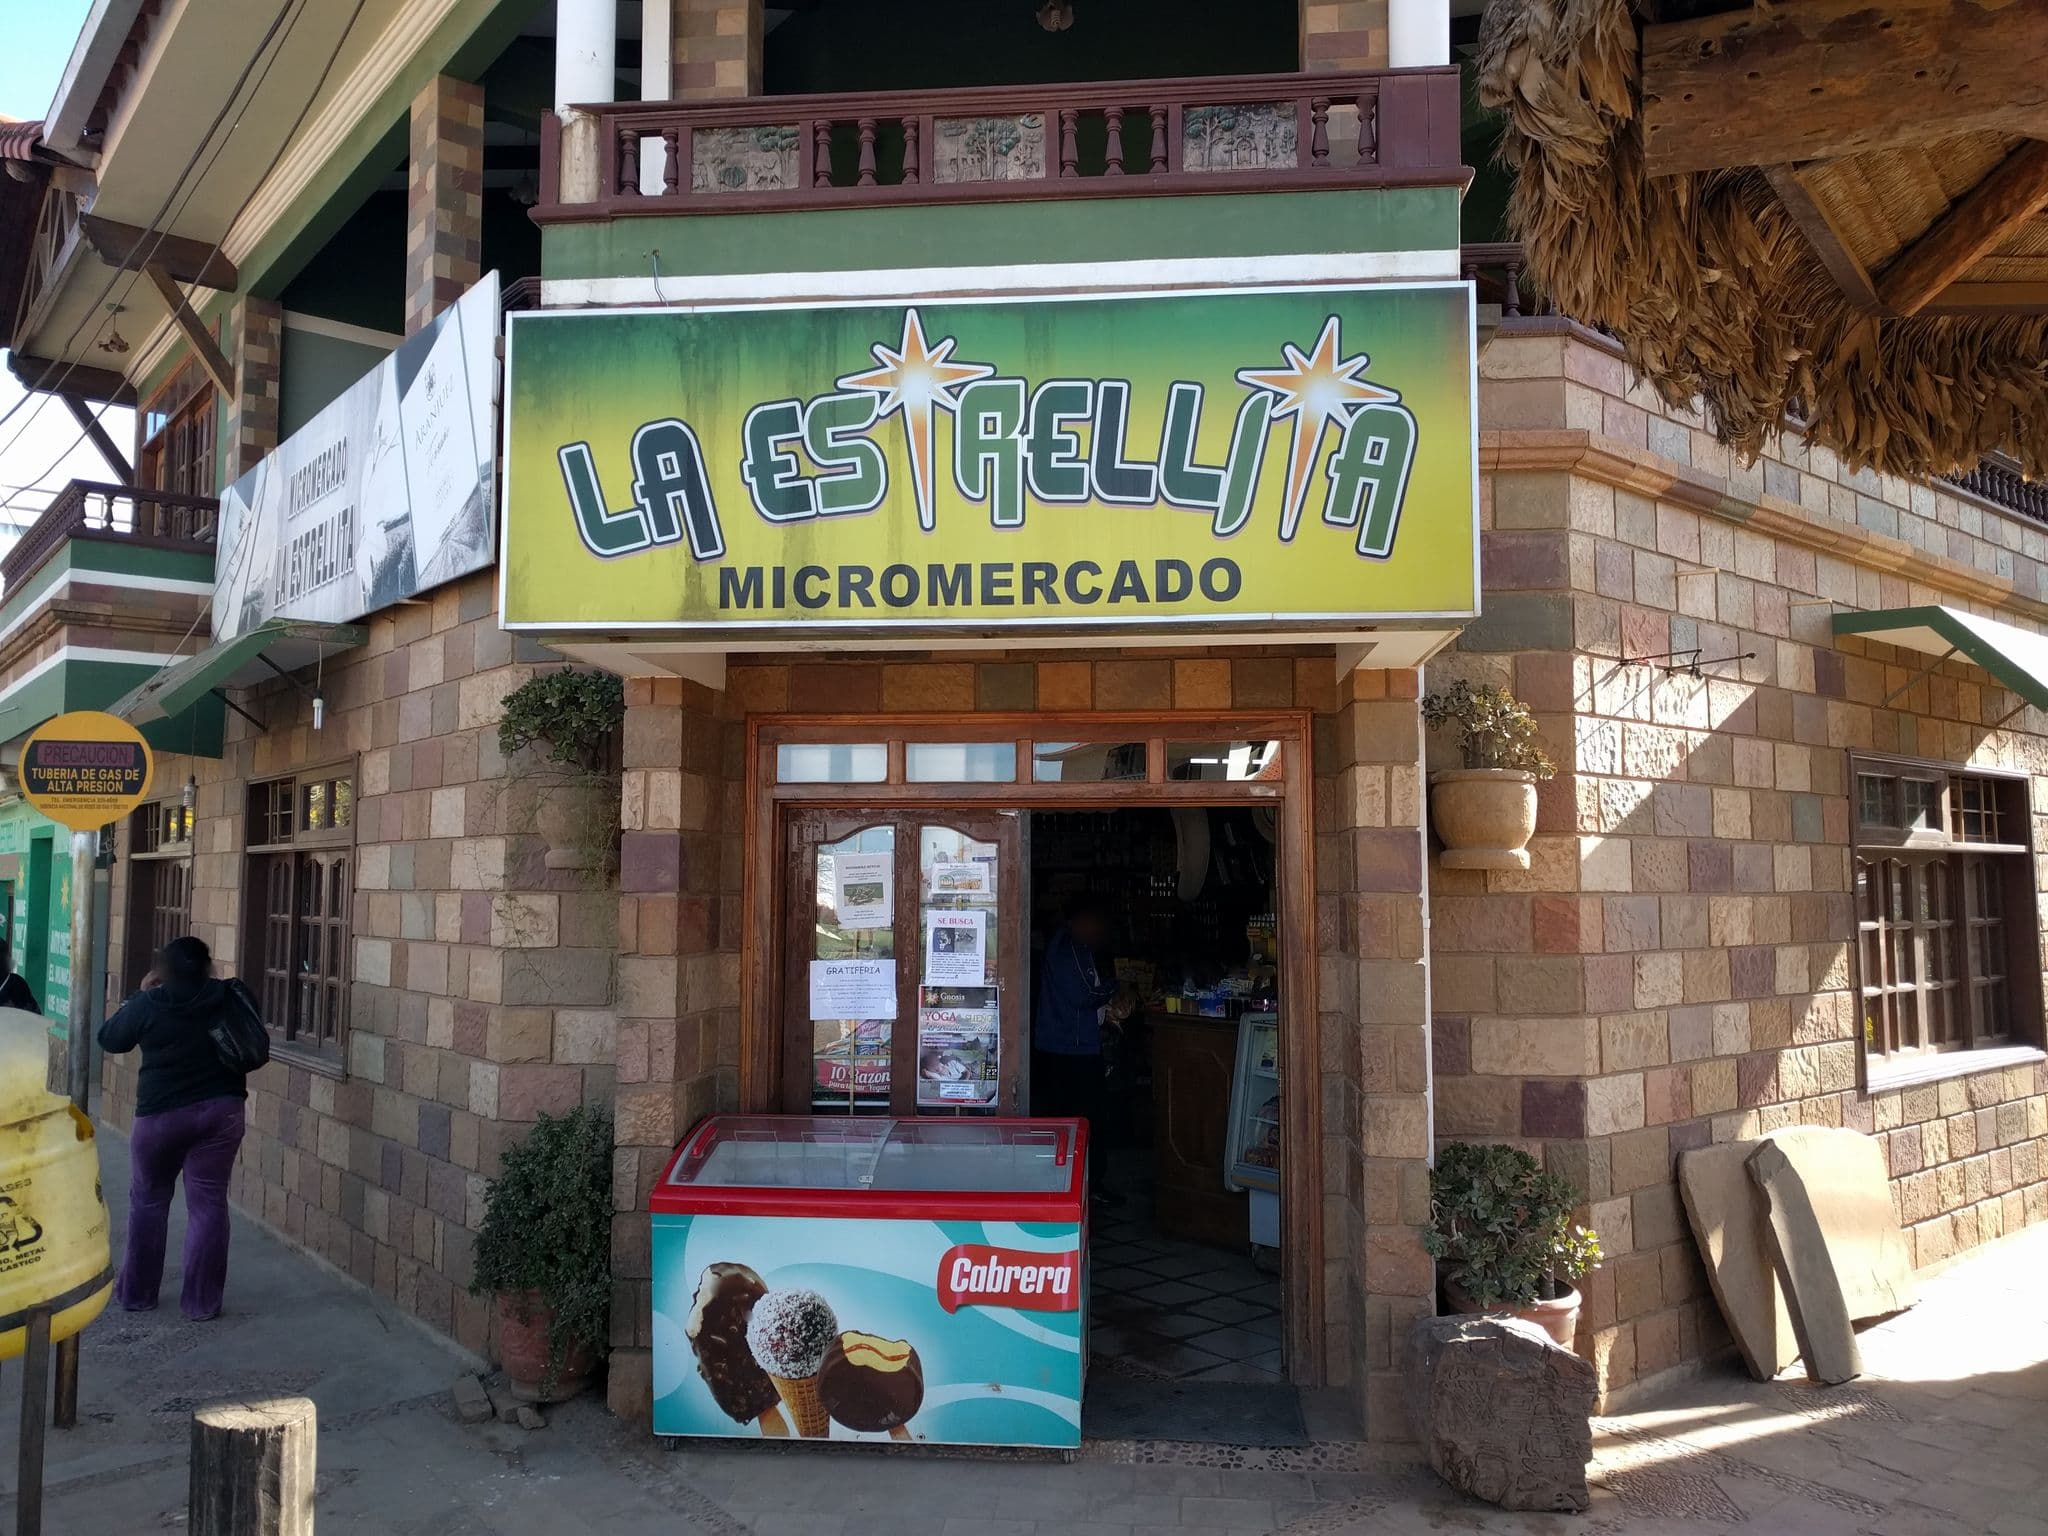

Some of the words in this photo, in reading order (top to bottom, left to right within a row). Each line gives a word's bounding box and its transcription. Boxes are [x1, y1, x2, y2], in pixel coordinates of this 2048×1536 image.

[558, 417, 726, 562] LA
[739, 308, 1417, 561] ESTRELLITA
[288, 436, 347, 520] MICROMERCADO
[274, 545, 288, 610] LA
[289, 505, 355, 603] ESTRELLITA
[719, 557, 1242, 611] MICROMERCADO
[44, 745, 128, 764] PRECAUCION
[32, 767, 78, 780] TUBERIA
[81, 768, 96, 780] DE
[98, 769, 122, 780] GAS
[125, 768, 140, 780] DE
[47, 780, 73, 792] ALTA
[76, 780, 123, 792] PRESION
[937, 917, 947, 925] SE
[949, 917, 974, 925] BUSCA
[826, 966, 881, 976] GRATIFERIA
[940, 991, 965, 1001] Gnosis
[925, 1011, 956, 1022] YOGA
[830, 1066, 846, 1081] 10
[16, 1247, 46, 1260] METAL
[950, 1255, 1072, 1294] Cabrera
